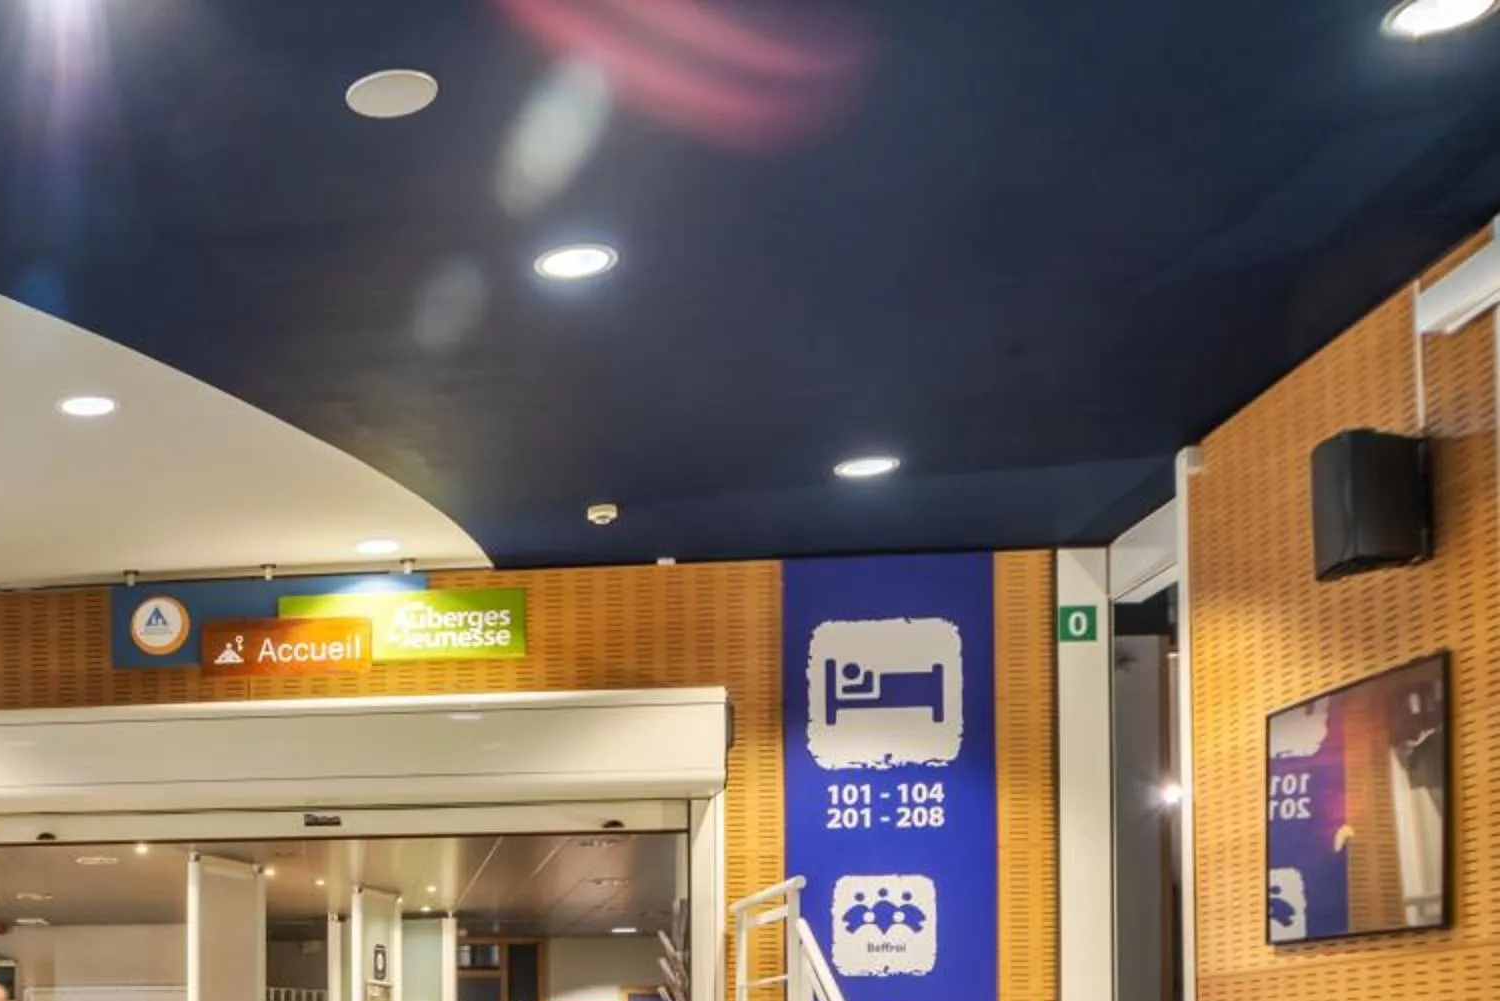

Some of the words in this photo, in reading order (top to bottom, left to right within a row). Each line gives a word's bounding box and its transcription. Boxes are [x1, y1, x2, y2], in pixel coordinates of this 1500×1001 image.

[1069, 611, 1088, 637] 0
[257, 635, 361, 663] Accueil
[827, 783, 872, 805] 101
[896, 781, 945, 804] 104
[826, 807, 872, 829] 201
[896, 806, 945, 828] 208
